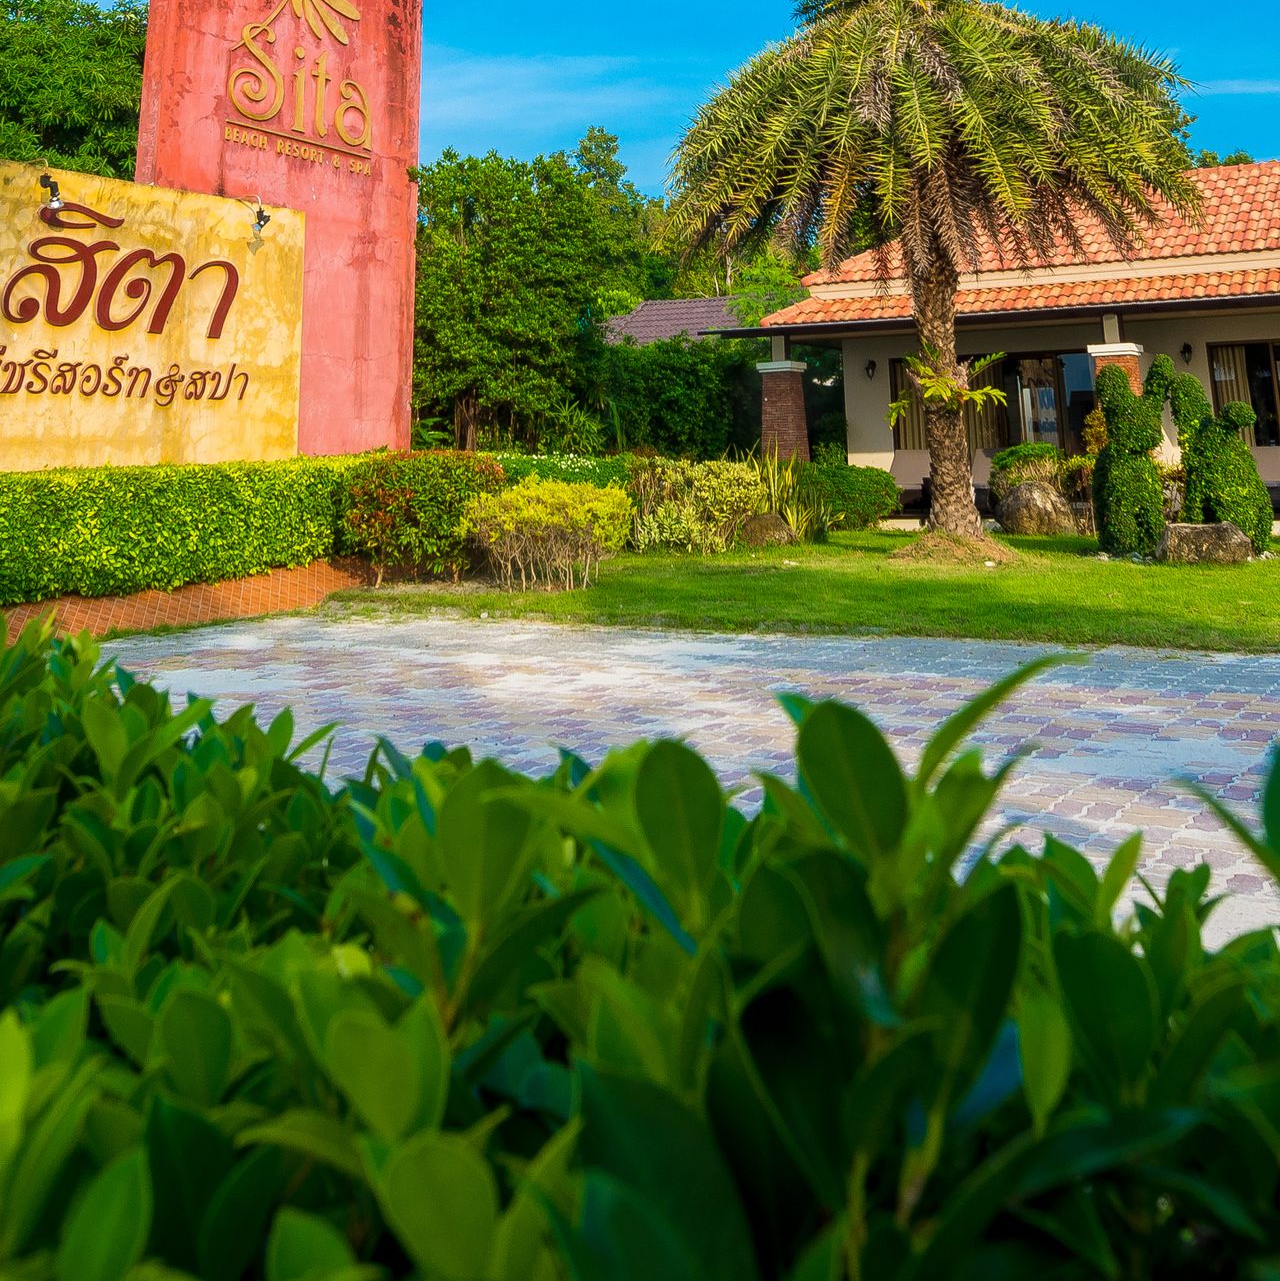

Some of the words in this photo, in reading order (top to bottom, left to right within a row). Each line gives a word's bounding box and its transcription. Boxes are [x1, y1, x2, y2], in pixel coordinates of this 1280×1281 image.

[227, 22, 372, 152] Sita
[224, 126, 268, 151] BEACH
[276, 139, 325, 165] RESORT
[331, 153, 341, 169] &
[349, 158, 371, 177] SPA
